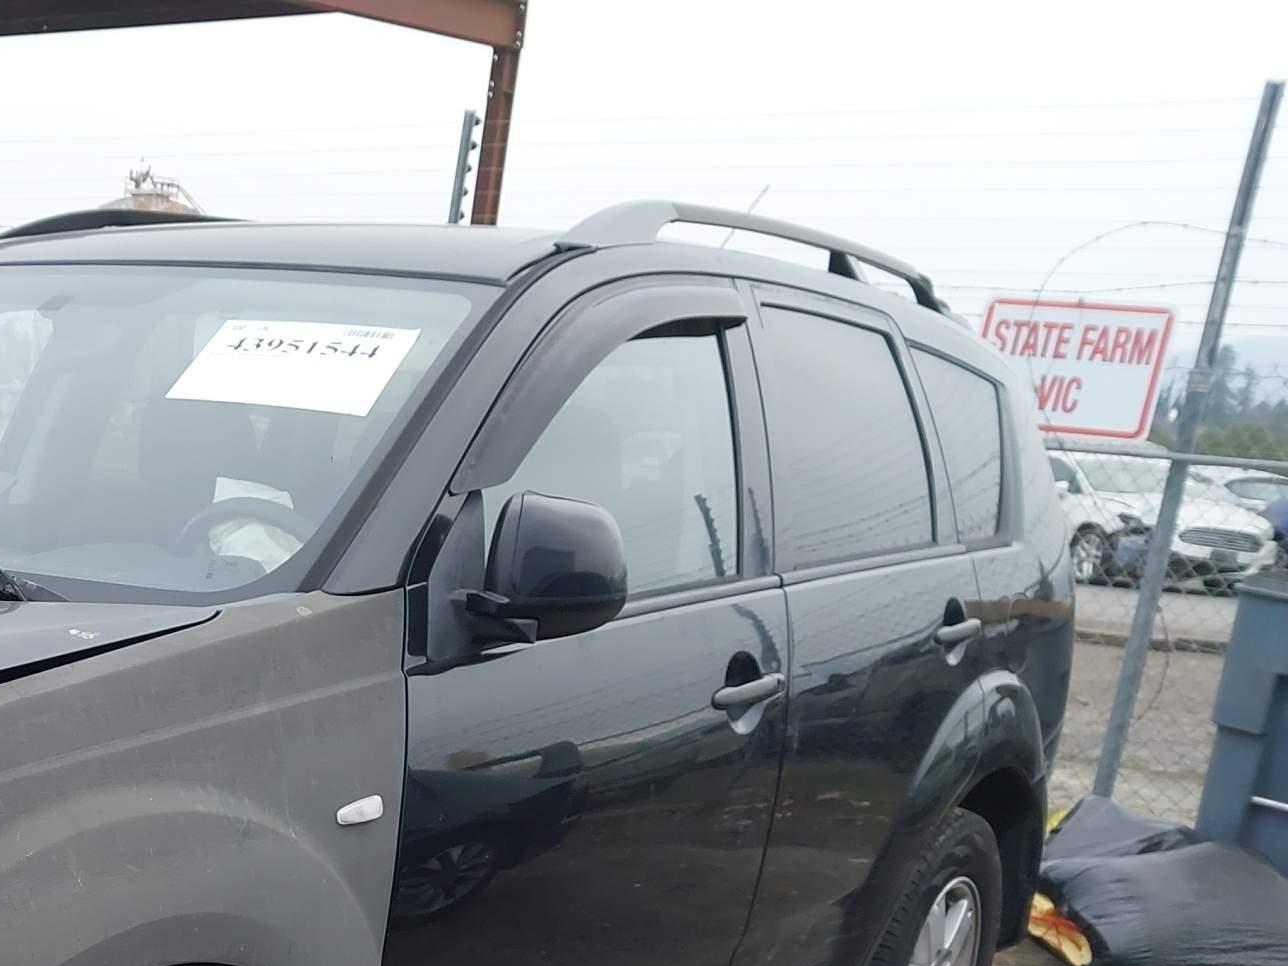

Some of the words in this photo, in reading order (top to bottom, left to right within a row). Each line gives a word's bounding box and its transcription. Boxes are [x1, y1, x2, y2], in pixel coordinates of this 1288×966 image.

[227, 336, 381, 359] 43951544
[994, 319, 1074, 359] STATE
[1076, 323, 1159, 366] FARM
[1037, 374, 1082, 414] VIC
